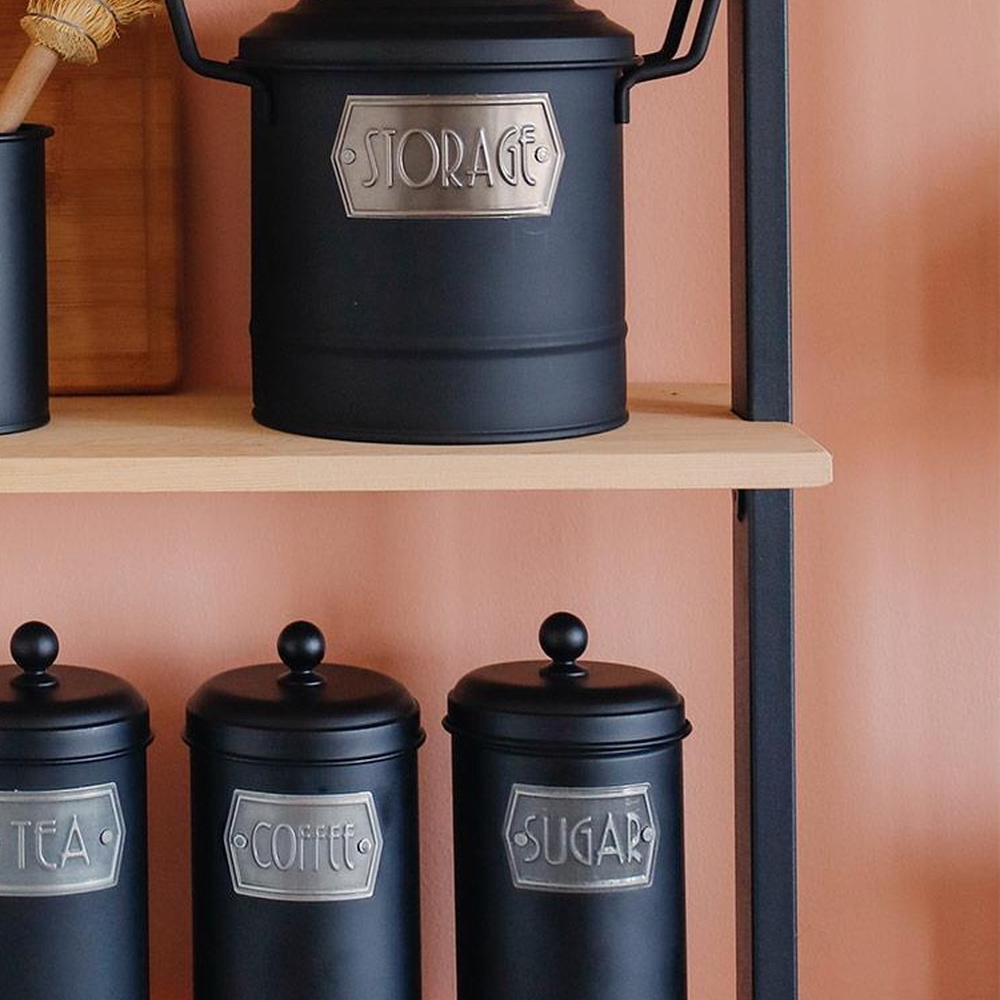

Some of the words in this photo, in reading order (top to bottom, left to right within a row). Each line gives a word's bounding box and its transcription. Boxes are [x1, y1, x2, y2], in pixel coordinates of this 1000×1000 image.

[361, 124, 536, 188] STORAGE
[10, 814, 91, 871] TEA
[251, 819, 356, 872] COFFEE
[523, 811, 643, 867] SUGAR
